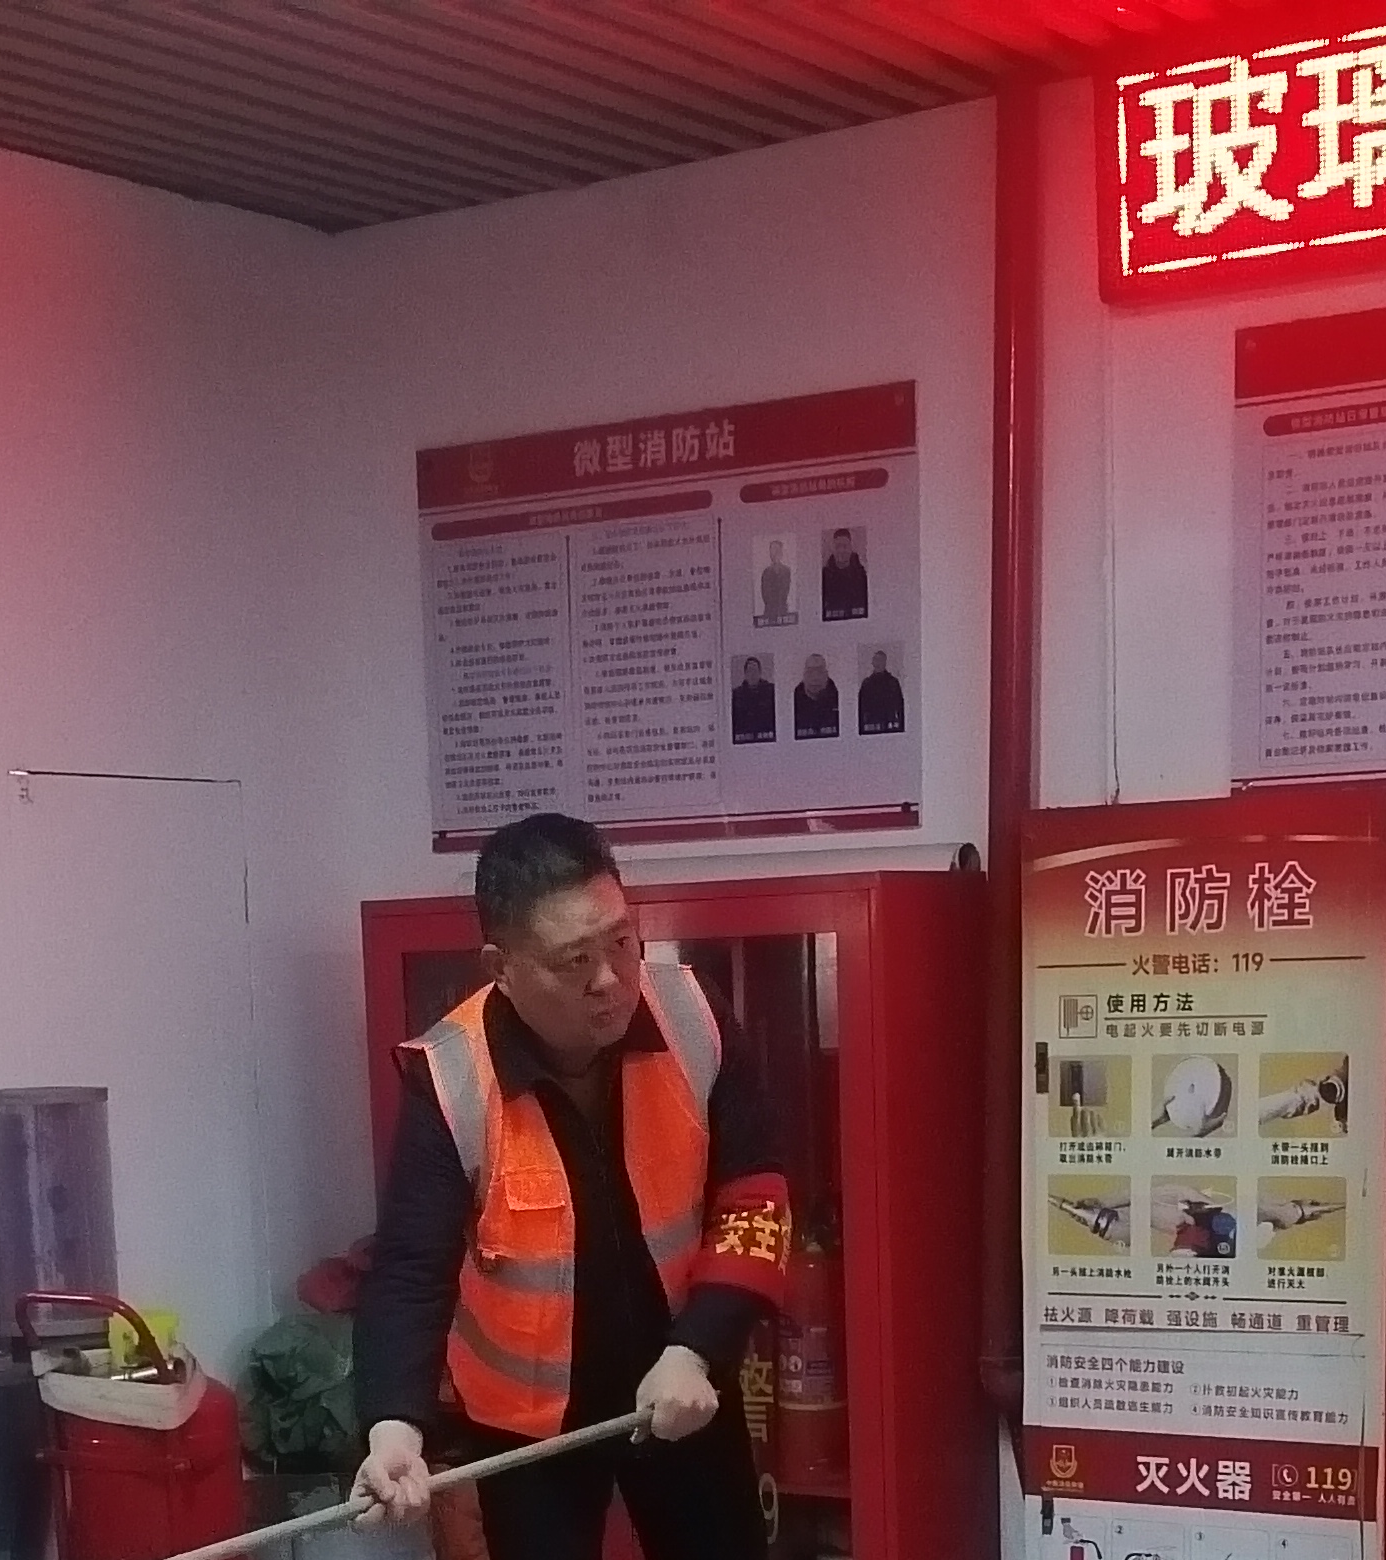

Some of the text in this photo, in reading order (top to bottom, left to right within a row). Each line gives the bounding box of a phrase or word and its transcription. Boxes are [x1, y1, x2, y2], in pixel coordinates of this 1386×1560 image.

[573, 418, 736, 477] 微型消防站
[1084, 860, 1317, 938] 消防栓
[1106, 993, 1195, 1014] 使用方法
[1106, 1021, 1266, 1038] 电起火要先切断电源
[1105, 1307, 1155, 1326] 降荷载
[1166, 1309, 1218, 1328] 强设施
[1230, 1311, 1283, 1331] 畅通道
[1296, 1314, 1349, 1333] 重管理
[1046, 1354, 1185, 1375] 消防安全四个能力建设
[1135, 1454, 1352, 1502] 灭火器 119
